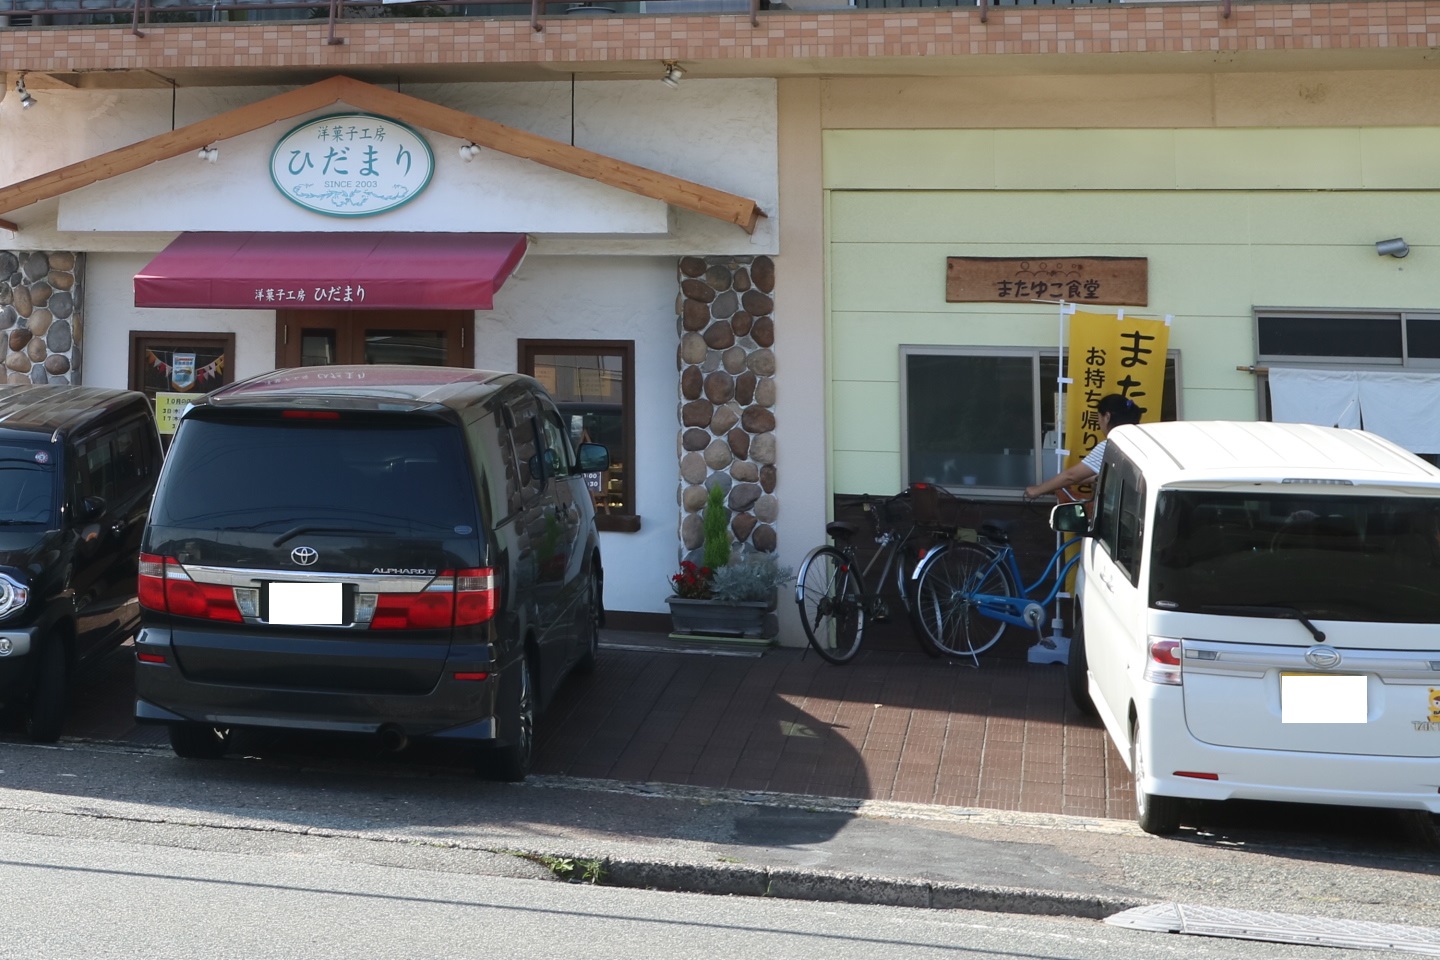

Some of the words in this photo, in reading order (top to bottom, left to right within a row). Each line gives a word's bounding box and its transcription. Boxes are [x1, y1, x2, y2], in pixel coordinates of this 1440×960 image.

[317, 125, 387, 142] 洋菓子工房
[288, 143, 412, 178] ひだまり
[324, 180, 352, 188] SINCE
[355, 180, 378, 188] 2003
[254, 288, 306, 302] 洋菓子工房
[314, 284, 366, 303] ひだまり
[997, 278, 1100, 299] またゆこ食堂
[372, 567, 426, 575] ALPHARD
